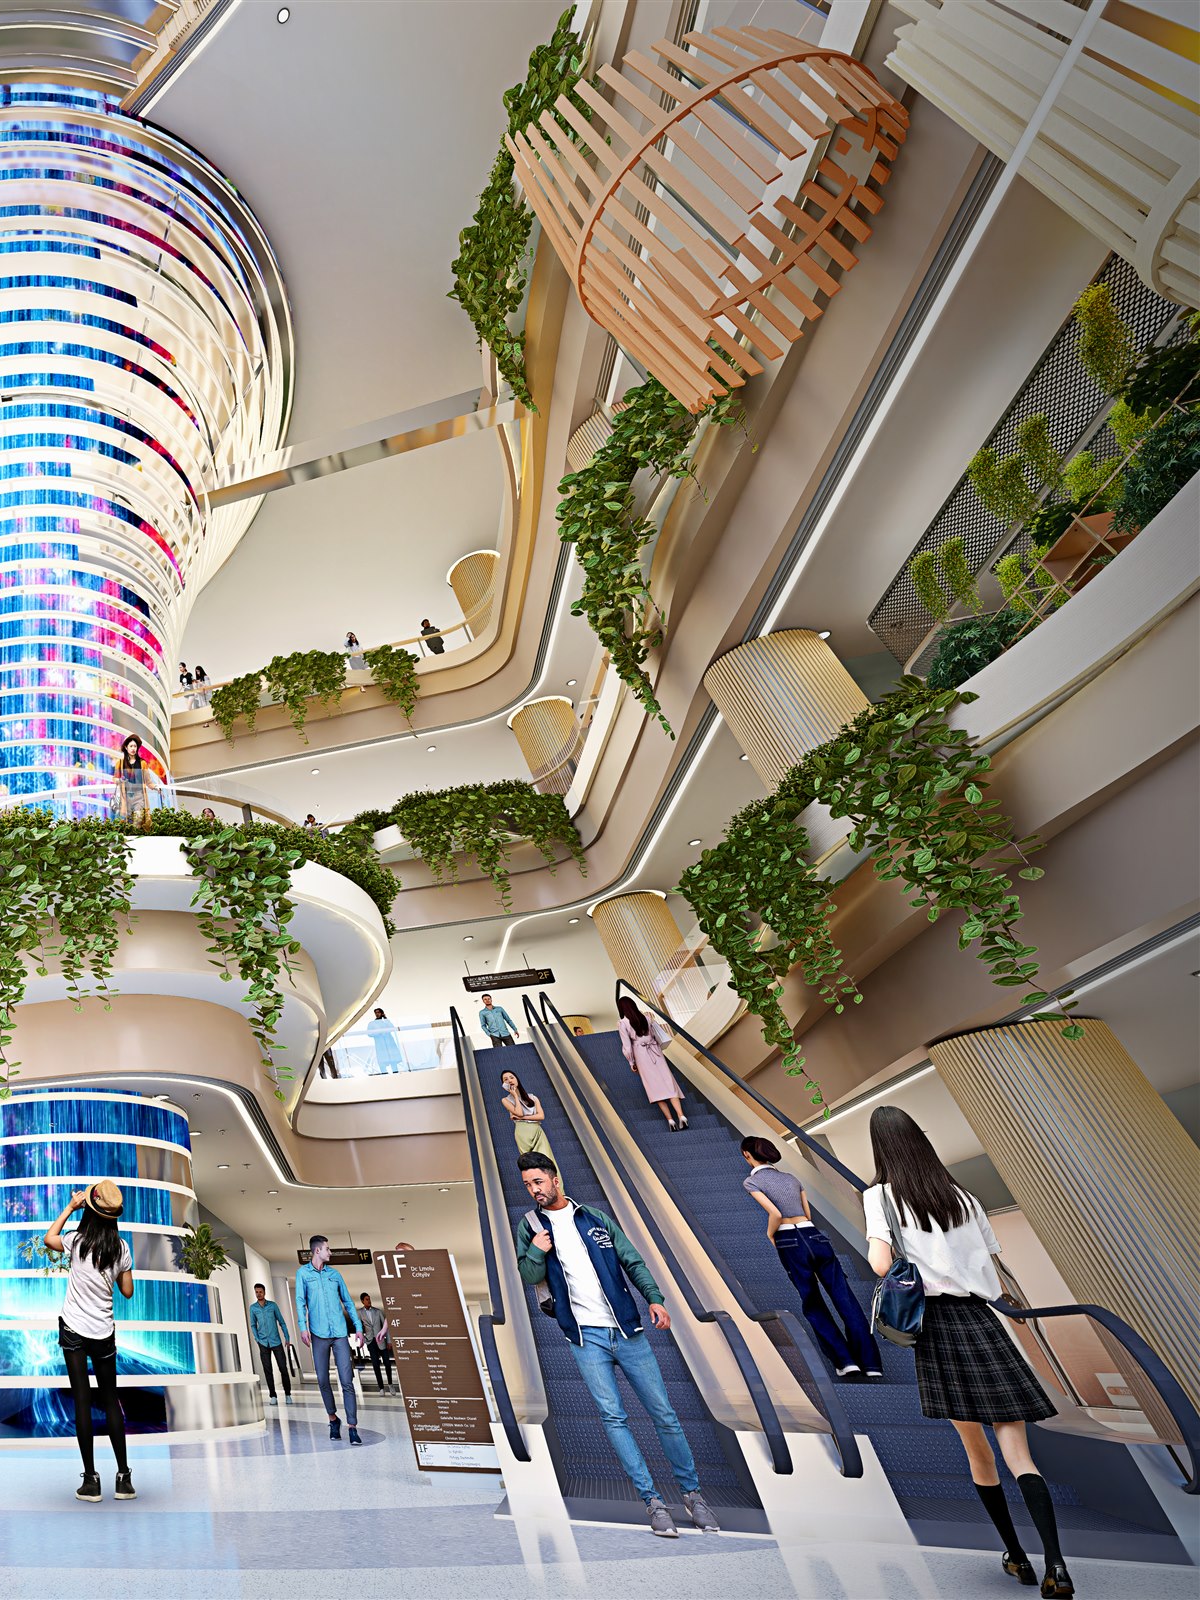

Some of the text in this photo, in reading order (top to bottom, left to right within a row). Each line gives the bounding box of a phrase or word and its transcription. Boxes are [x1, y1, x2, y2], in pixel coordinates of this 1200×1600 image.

[538, 971, 550, 980] 2F
[359, 1252, 369, 1261] 1F
[377, 1254, 407, 1279] 1F
[385, 1297, 396, 1306] 5F
[391, 1319, 400, 1328] 4F
[395, 1340, 405, 1348] 3F
[408, 1400, 418, 1408] 2F
[418, 1444, 428, 1453] 1F
